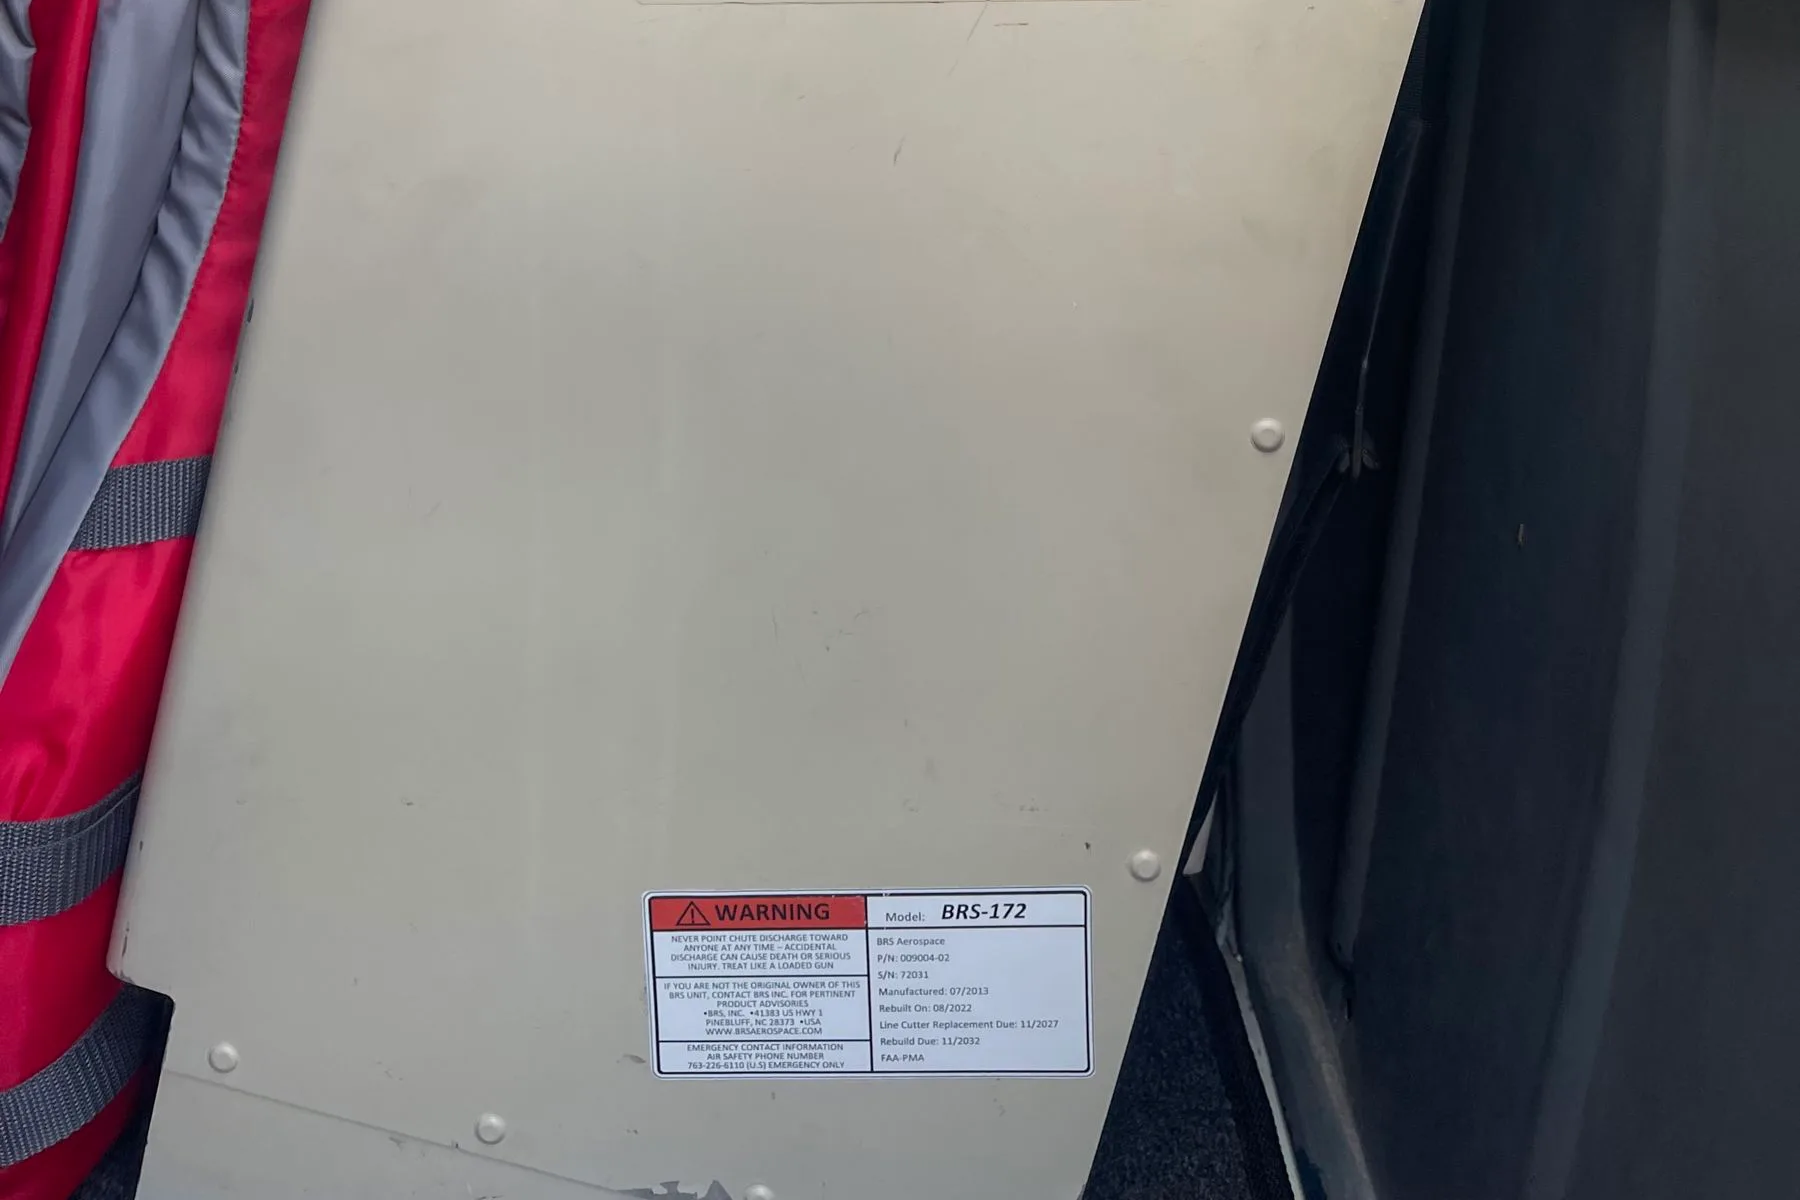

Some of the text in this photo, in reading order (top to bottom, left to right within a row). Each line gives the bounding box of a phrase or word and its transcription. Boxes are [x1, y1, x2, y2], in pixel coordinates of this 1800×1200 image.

[715, 903, 830, 921] WARNING
[885, 903, 1027, 922] Model: BRS-172
[671, 935, 699, 943] NEVER
[701, 935, 727, 943] POINT
[729, 934, 757, 942] CHUTE
[759, 934, 808, 942] DISCHARGE
[876, 937, 946, 947] BRS Aerospace
[683, 944, 719, 952] ANYONE
[721, 944, 732, 952] AT
[734, 943, 752, 951] ANY
[753, 943, 775, 951] TIME
[784, 943, 836, 951] ACCIDENTAL
[670, 952, 851, 961] DISCHARGE CAN CAUSE DEATH OR SERIOUS
[877, 954, 950, 963] P/N: 009004-02
[722, 962, 747, 970] TREAT
[750, 962, 767, 970] LIKE
[769, 962, 776, 970] A
[778, 962, 812, 970] LOADED
[814, 962, 834, 970] GUN
[877, 970, 929, 980] S/N: 72031
[664, 982, 671, 990] IF
[673, 982, 691, 990] YOU
[693, 982, 710, 990] ARE
[712, 982, 731, 990] NOT
[750, 981, 791, 989] ORIGINAL
[793, 981, 826, 989] OWNER
[828, 981, 840, 989] OF
[841, 981, 860, 989] THIS
[669, 991, 685, 999] BRS
[687, 991, 710, 1000] UNIT,
[711, 991, 752, 999] CONTACT
[754, 991, 770, 999] BRS
[809, 990, 855, 998] PERTINENT
[878, 987, 989, 996] Manufactured: 07/2013
[717, 1000, 809, 1008] PRODUCT ADVISORIES
[879, 1004, 972, 1013] Rebuilt On: 08/2022
[782, 1009, 794, 1017] US
[795, 1009, 816, 1017] HWY
[818, 1009, 823, 1017] 1
[705, 1019, 753, 1027] PINEBLUFF,
[755, 1018, 768, 1026] NC
[769, 1018, 795, 1026] 28373
[879, 1020, 1059, 1030] Line Cutter Replacement Due: 11/2027
[705, 1027, 823, 1036] WWW.BRSAEROSPACE.COM
[880, 1037, 980, 1046] Rebuild Due: 11/2032
[687, 1043, 844, 1052] EMERGENCY CONTACT INFORMATION
[707, 1052, 824, 1061] AIR SAFETY PHONE NUMBER
[881, 1054, 925, 1062] FAA-PMA
[688, 1062, 744, 1070] 763-226-6110
[768, 1061, 820, 1069] EMERGENCY
[822, 1061, 844, 1069] ONLY
